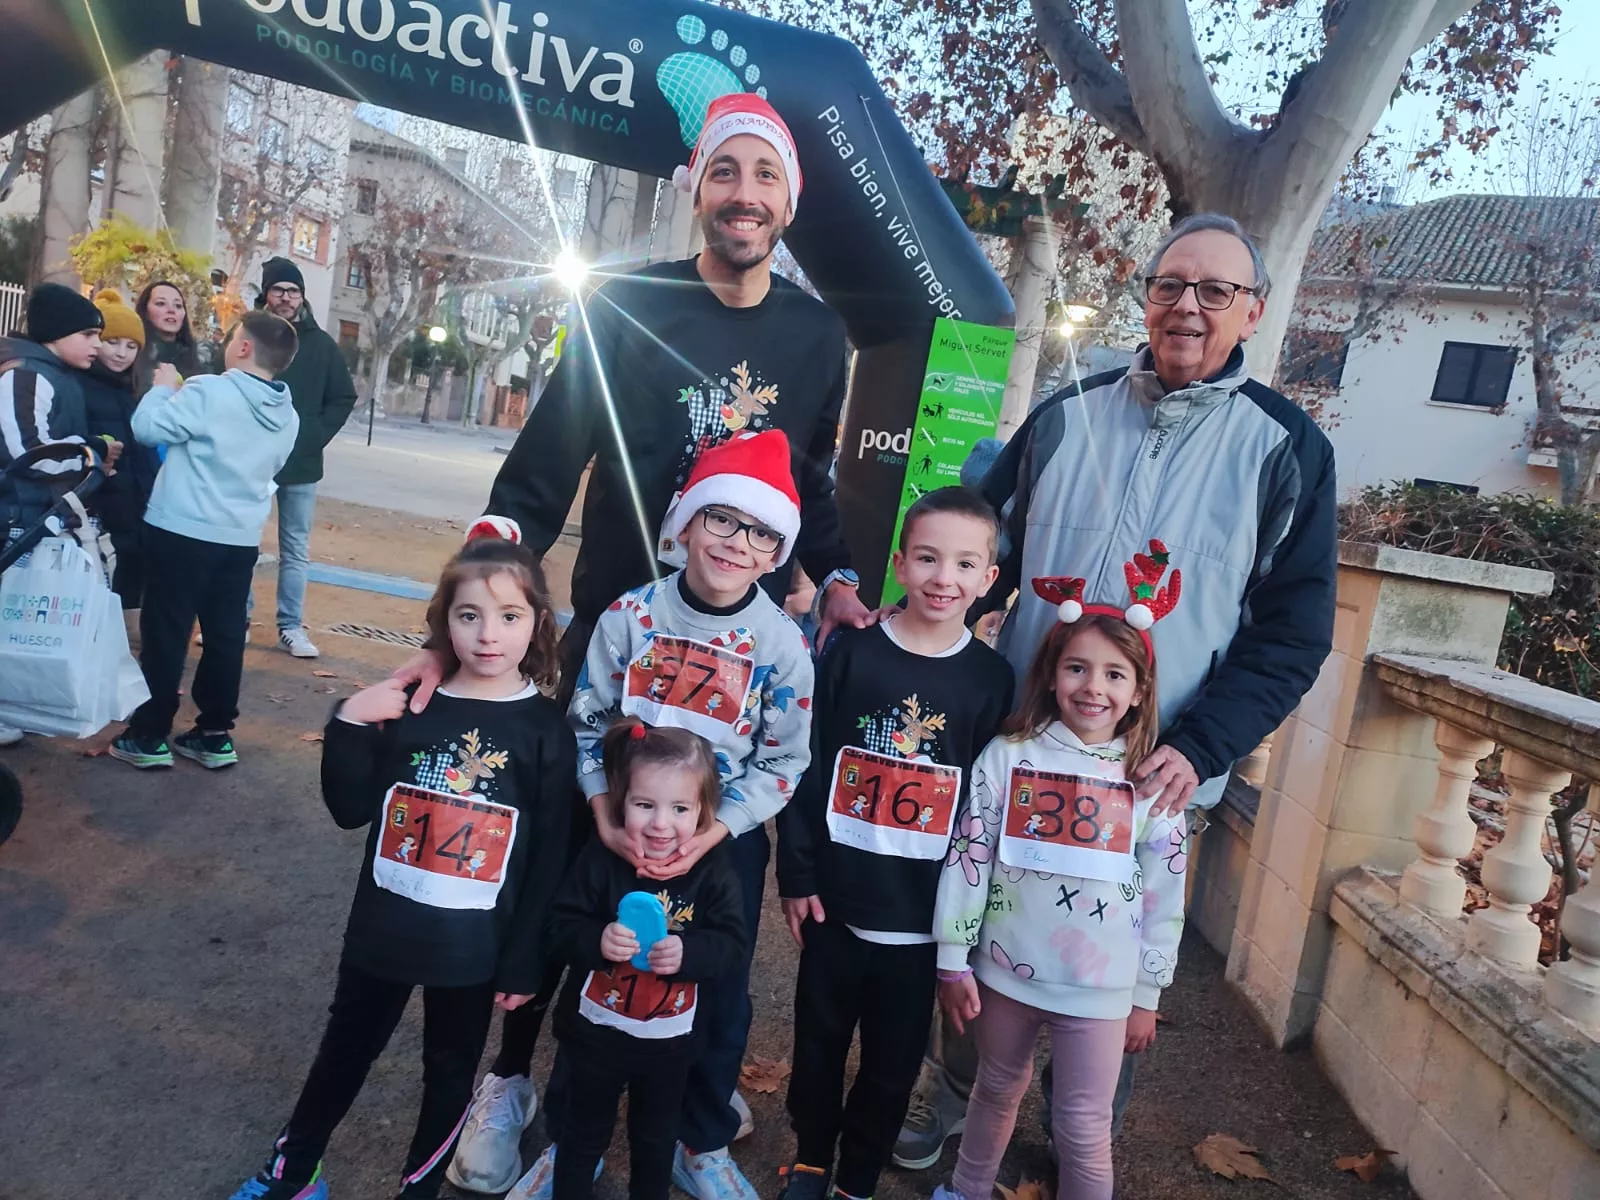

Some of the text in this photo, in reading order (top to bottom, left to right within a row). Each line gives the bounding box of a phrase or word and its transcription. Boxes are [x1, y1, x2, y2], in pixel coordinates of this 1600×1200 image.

[185, 0, 635, 109] doactiva
[256, 23, 630, 137] PODOLOGÍA Y BIOMECÁNICA
[818, 105, 964, 321] Pisa bien, vive mejor
[940, 338, 1006, 358] Miguel Servet
[9, 632, 63, 649] HUESCA
[865, 774, 922, 826] 16
[1033, 790, 1101, 844] 38
[413, 812, 475, 872] 14
